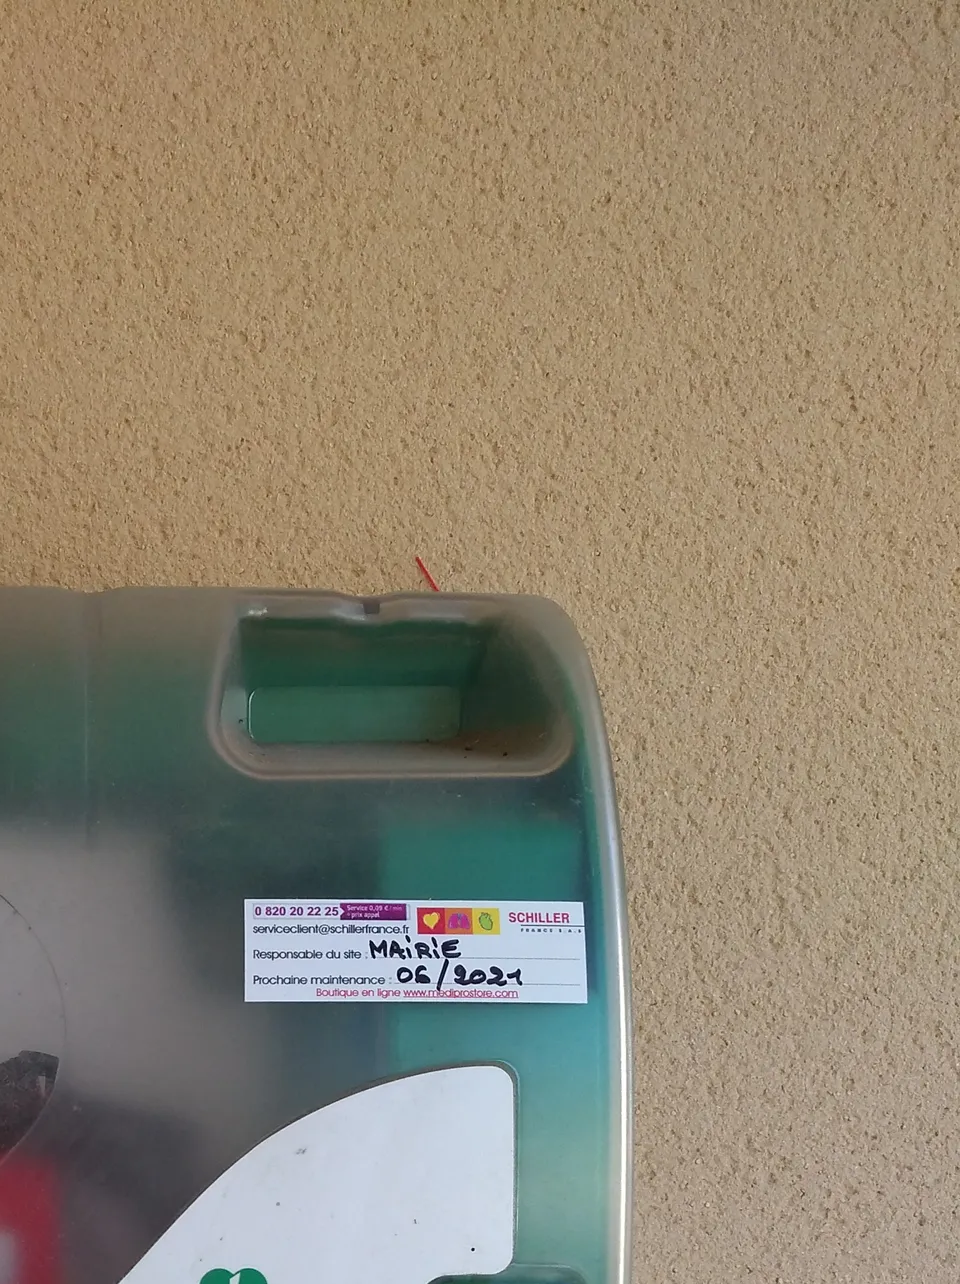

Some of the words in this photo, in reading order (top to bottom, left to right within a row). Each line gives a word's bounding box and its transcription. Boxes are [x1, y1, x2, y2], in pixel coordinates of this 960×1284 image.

[254, 906, 262, 916] 0
[265, 906, 286, 916] 820
[289, 906, 304, 916] 20
[307, 906, 322, 916] 22
[324, 906, 339, 916] 25
[508, 912, 570, 924] SCHILLER
[252, 923, 410, 935] serviceclient@schillerfrance.fr
[252, 949, 323, 961] Responsable
[325, 949, 341, 959] du
[343, 949, 362, 959] site
[252, 974, 308, 985] Prochaine
[310, 974, 386, 985] maintenance
[396, 958, 524, 991] 06/2021
[316, 987, 359, 998] Boutique
[361, 989, 374, 997] en
[377, 988, 401, 998] ligne
[403, 988, 519, 999] www.mediprostore.com
